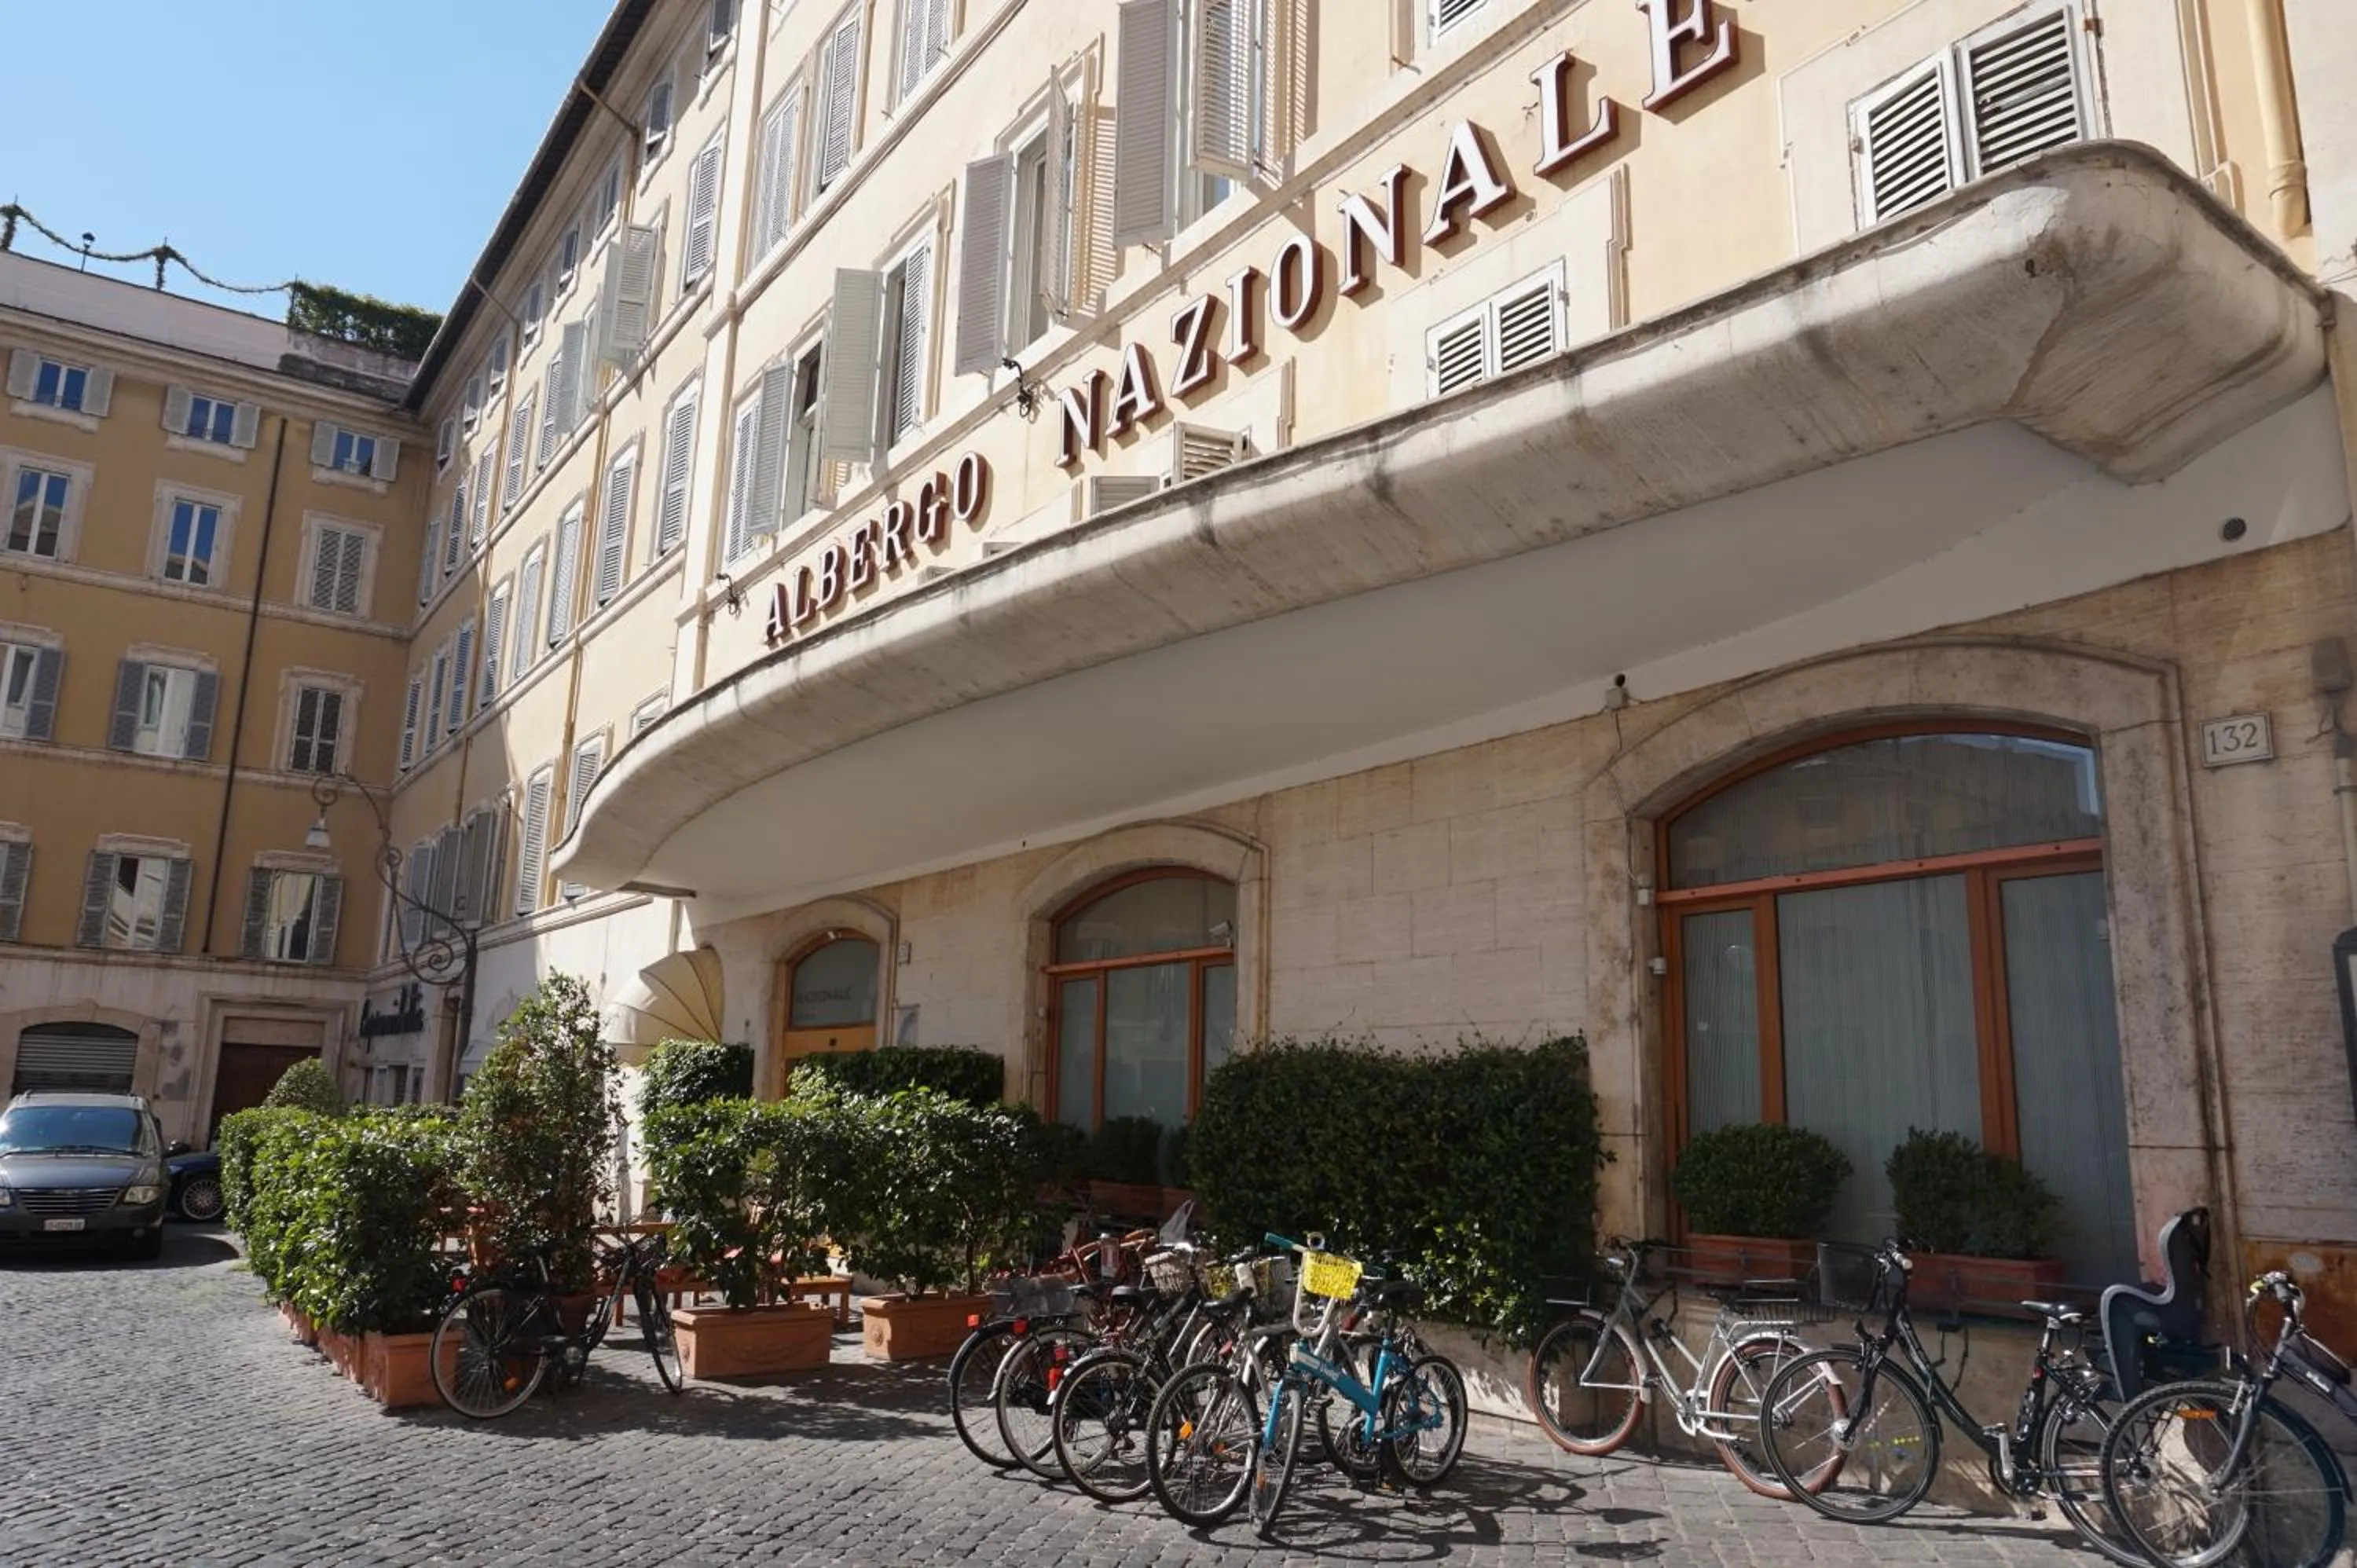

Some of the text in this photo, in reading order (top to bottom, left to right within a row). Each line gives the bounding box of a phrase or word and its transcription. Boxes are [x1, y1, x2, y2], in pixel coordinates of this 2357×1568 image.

[764, 0, 1740, 641] ALBERGO NAZIONALE
[2209, 722, 2258, 755] 132
